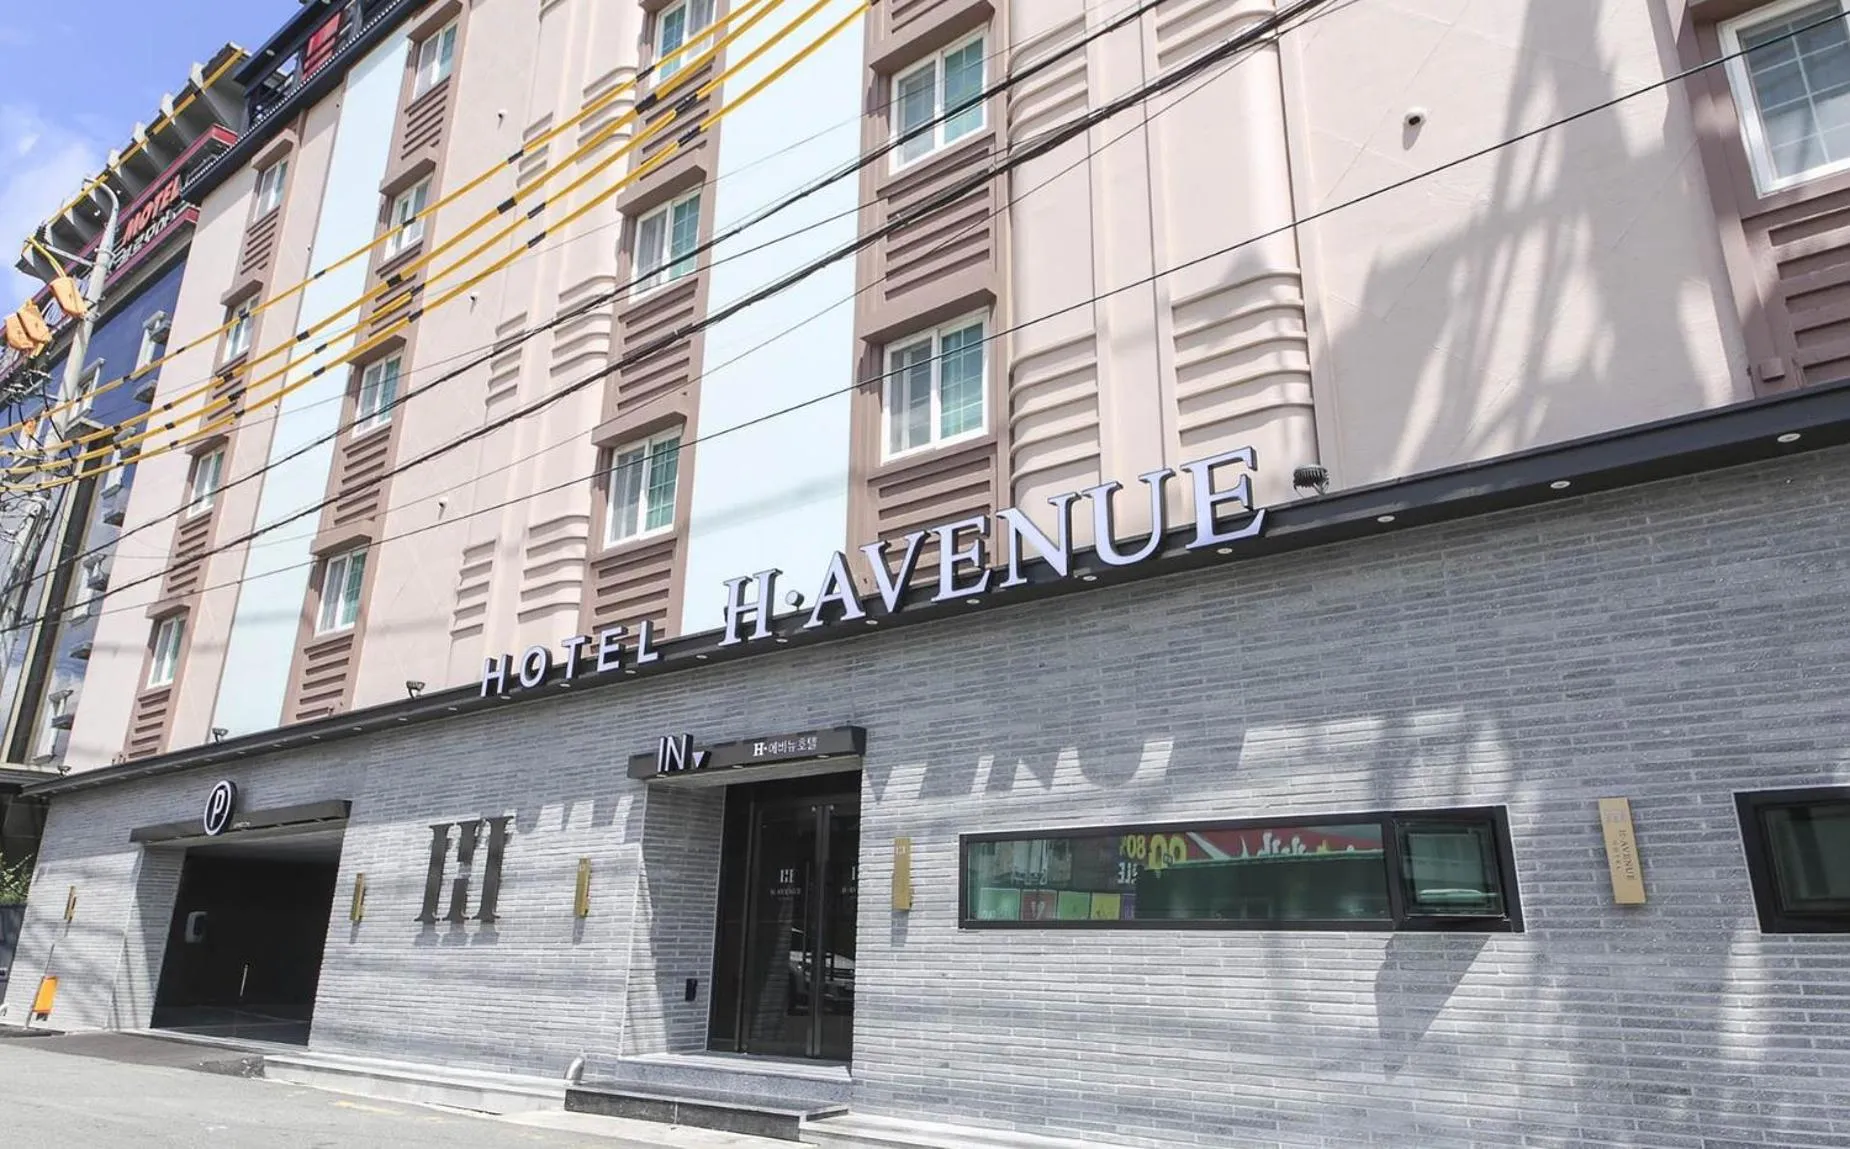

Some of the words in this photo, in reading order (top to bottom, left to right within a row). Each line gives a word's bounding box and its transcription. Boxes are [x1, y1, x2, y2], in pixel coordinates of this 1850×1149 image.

[122, 173, 181, 246] MOTEL
[480, 619, 661, 698] HOTEL
[657, 733, 694, 773] IN
[209, 789, 226, 830] P
